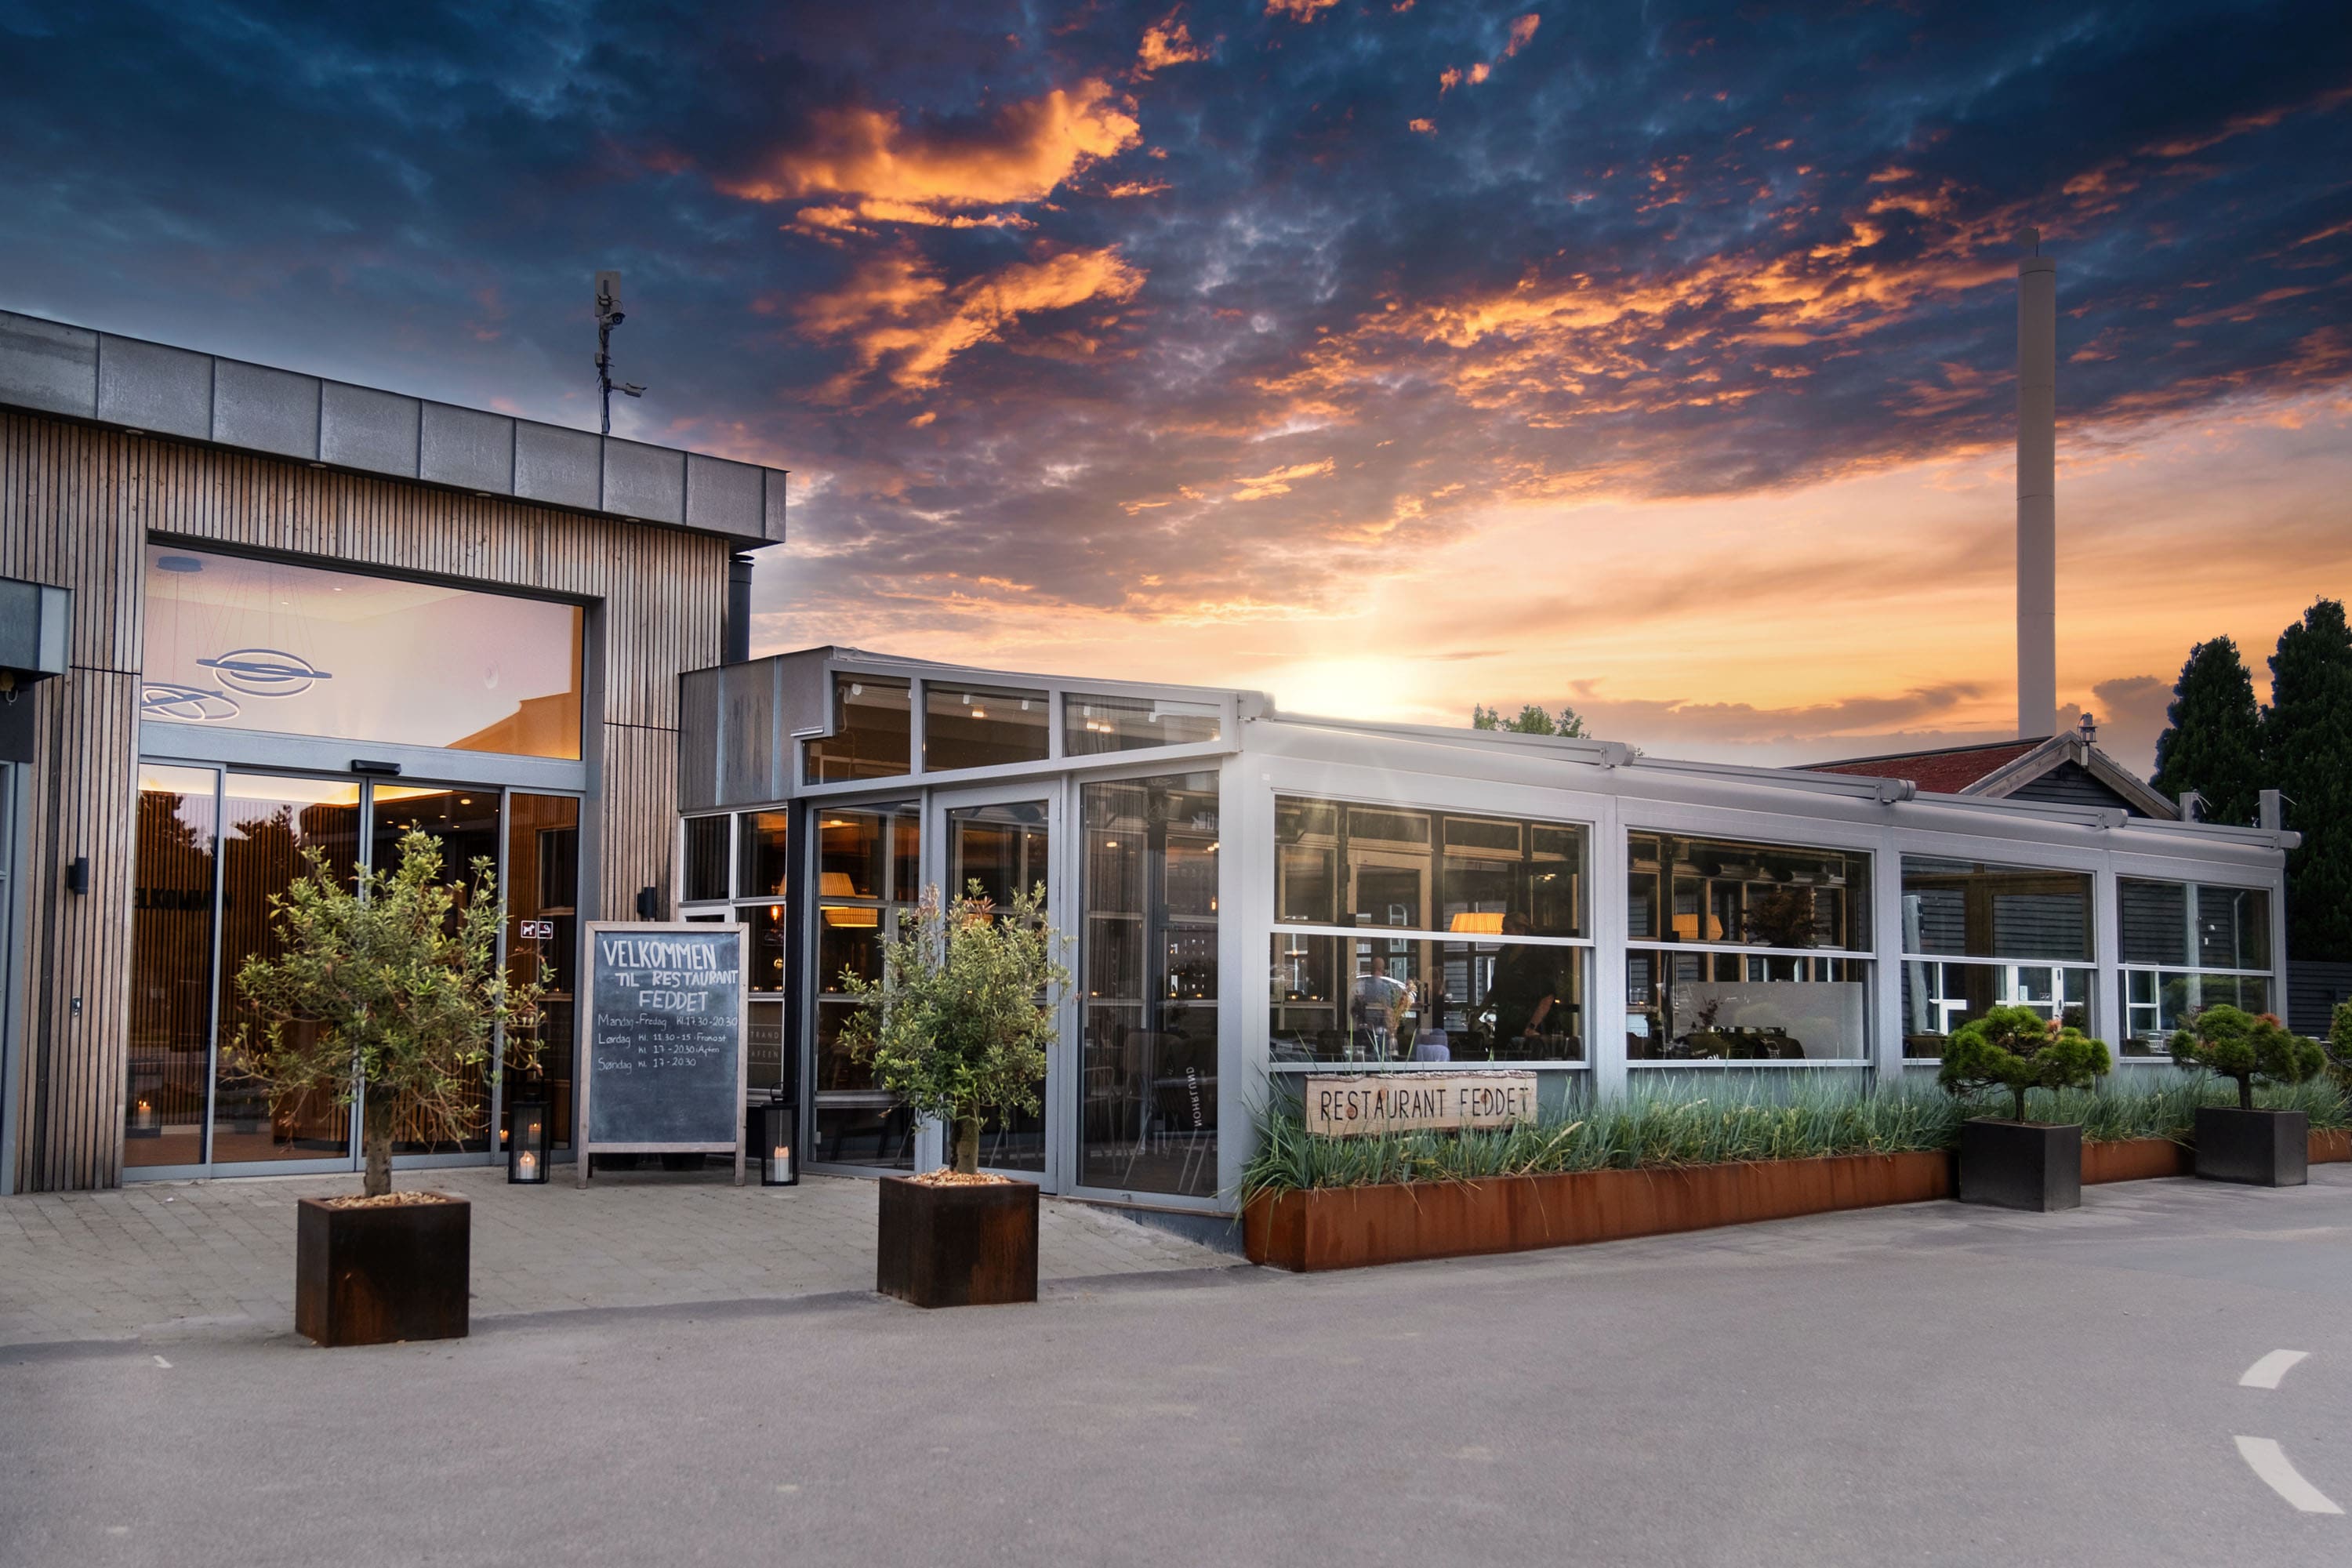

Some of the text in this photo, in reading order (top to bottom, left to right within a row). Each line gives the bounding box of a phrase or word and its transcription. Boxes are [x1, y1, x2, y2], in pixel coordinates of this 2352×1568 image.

[603, 940, 717, 970] VELKOMMEN
[615, 970, 739, 988] TIL RESTAURANT
[639, 989, 708, 1012] FEDDET
[598, 1033, 631, 1049] Lørdag
[1321, 1087, 1529, 1121] RESTAURANT FEDDET
